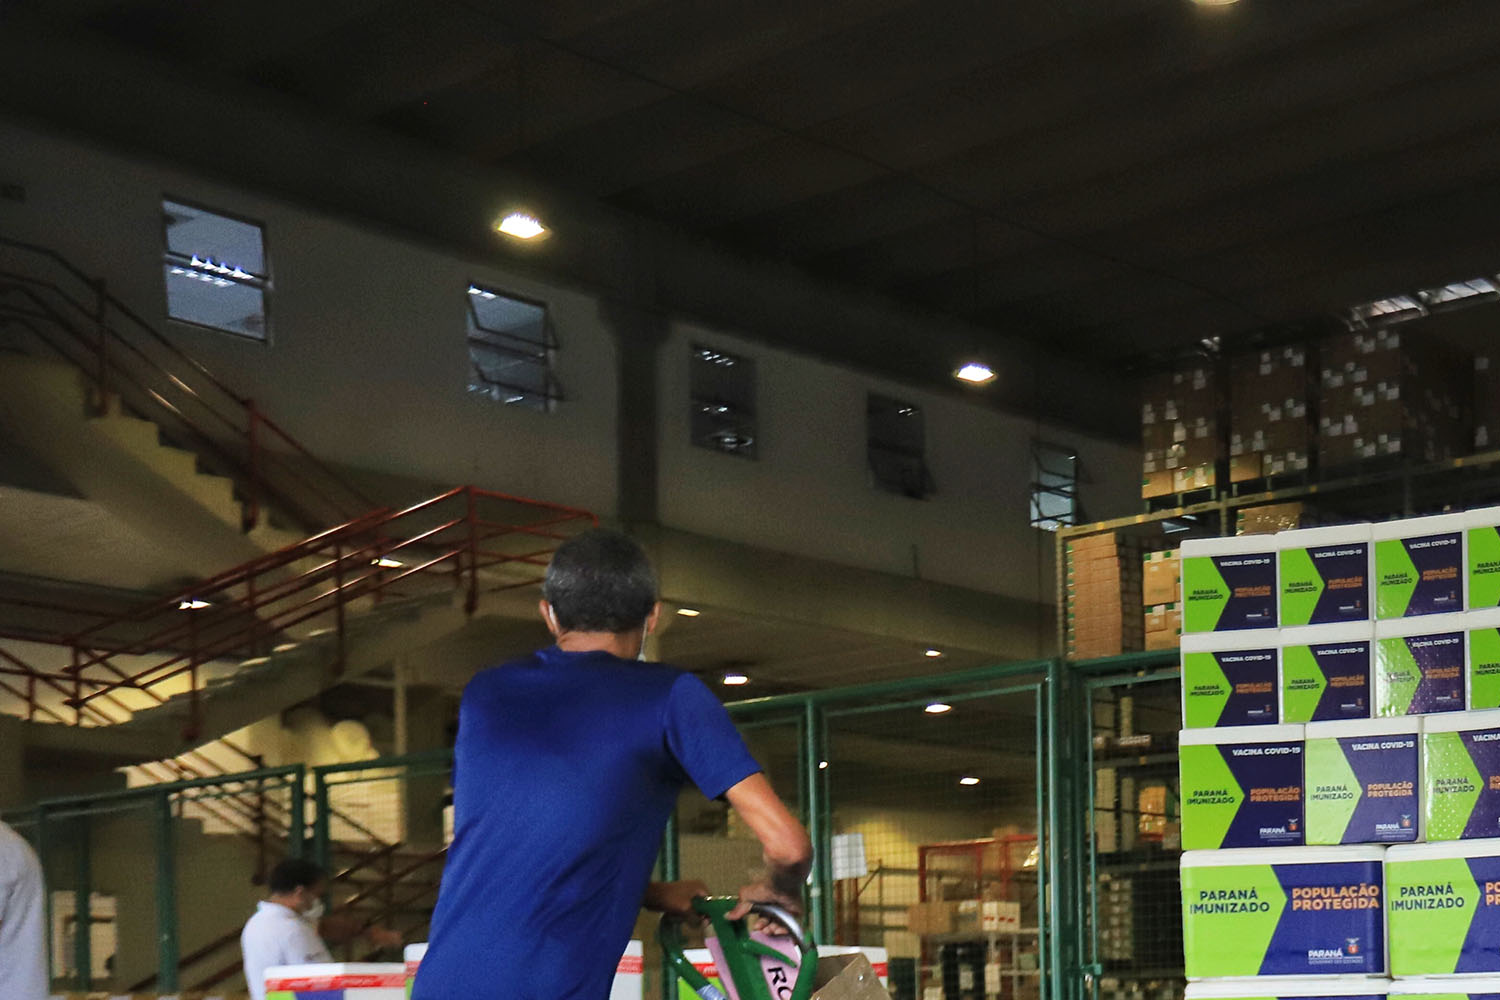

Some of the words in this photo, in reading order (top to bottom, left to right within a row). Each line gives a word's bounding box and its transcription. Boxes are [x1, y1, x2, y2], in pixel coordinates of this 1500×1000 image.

[1351, 743, 1380, 751] VACINA
[1381, 741, 1414, 750] COVID-19
[1316, 784, 1348, 793] PARANÁ
[1367, 781, 1414, 791] POPULAÇÃO
[1310, 791, 1354, 801] IMUNIZADO
[1367, 789, 1414, 798] PROTEGIDA
[1200, 887, 1258, 900] PARANÁ
[1292, 883, 1380, 899] POPULAÇÃO
[1400, 882, 1455, 897] PARANÁ
[1190, 901, 1270, 914] IMUNIZADO
[1292, 897, 1380, 911] PROTEGIDA
[1391, 897, 1465, 911] IMUNIZADO
[1308, 948, 1343, 958] PARANÁ
